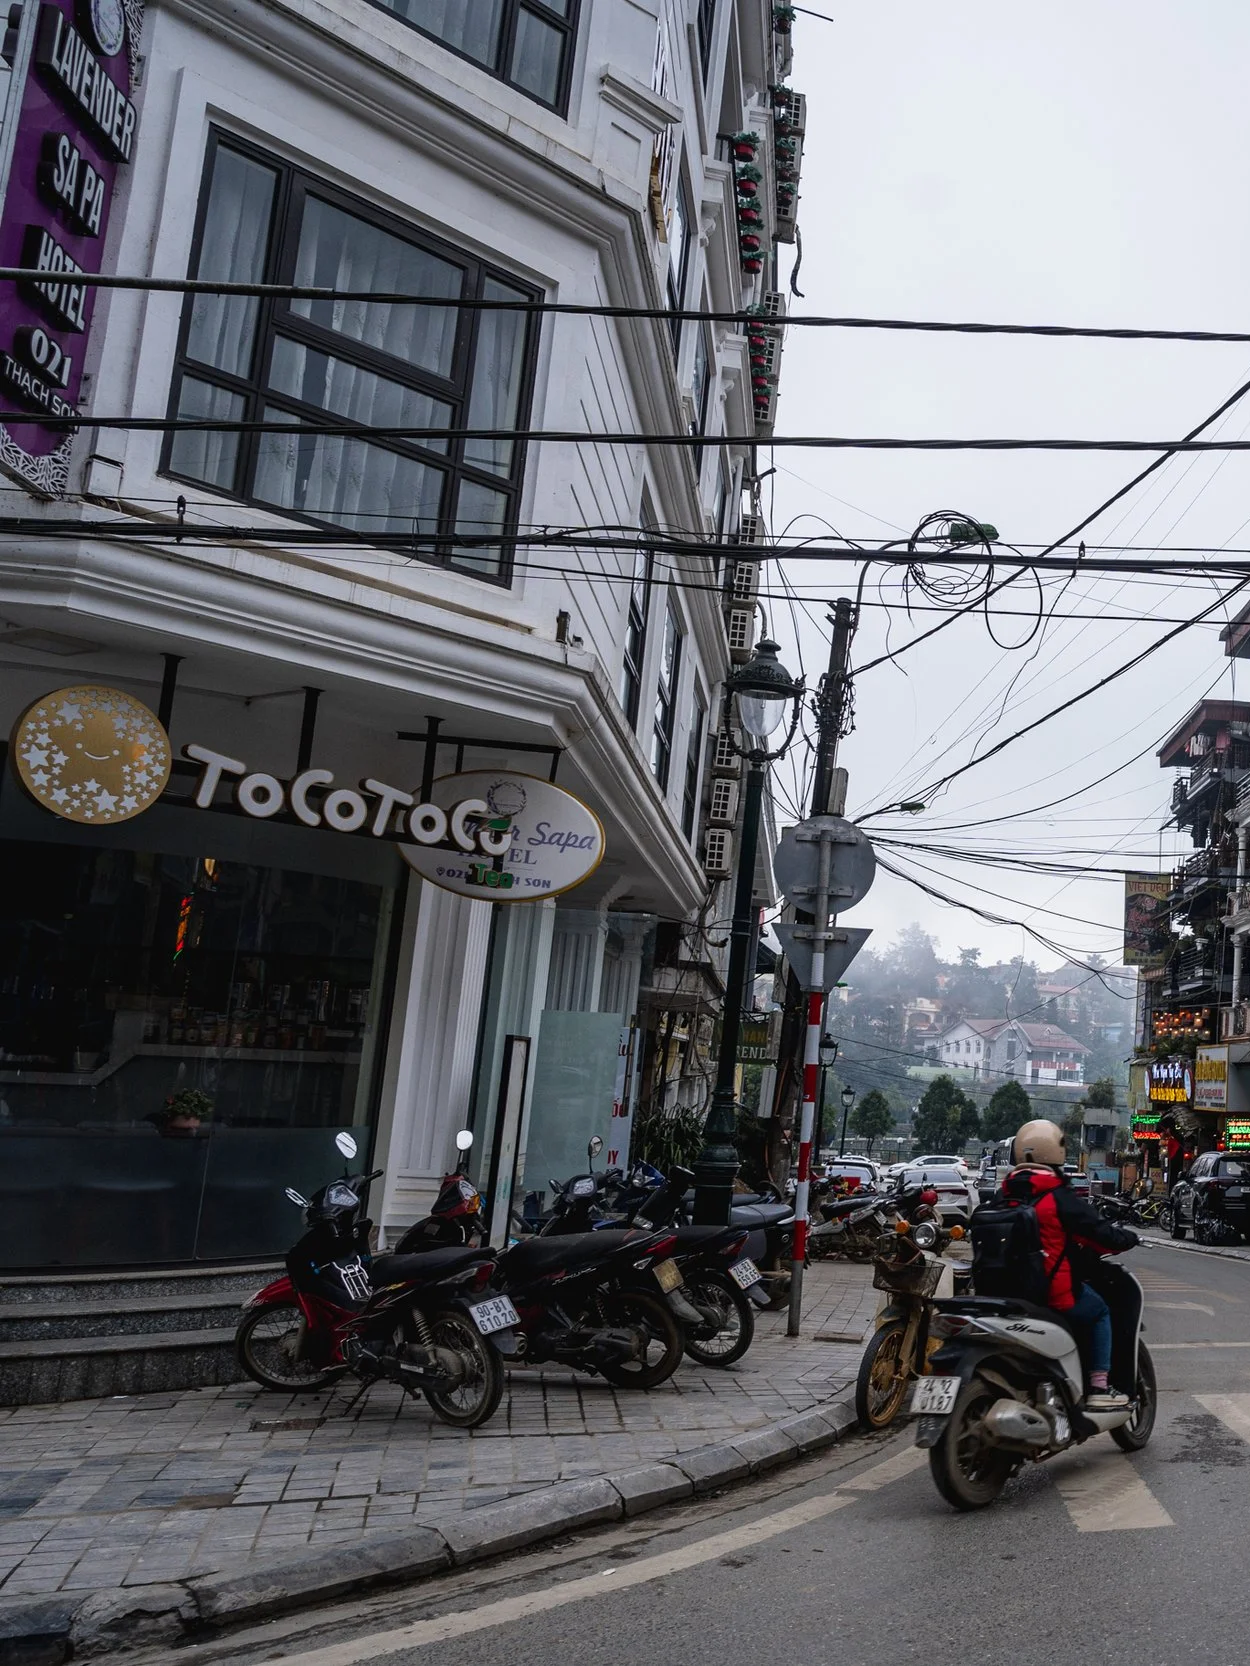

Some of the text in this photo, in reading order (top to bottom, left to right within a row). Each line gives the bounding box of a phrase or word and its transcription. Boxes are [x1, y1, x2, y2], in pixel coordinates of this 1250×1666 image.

[51, 11, 136, 159] LAVENDER
[54, 135, 105, 235] SA PA
[35, 232, 87, 331] HOTEL
[31, 329, 72, 386] 021
[5, 355, 50, 405] THẠCH
[528, 822, 595, 852] Sapa
[474, 863, 513, 888] Tea
[476, 1301, 507, 1319] 90-B1
[481, 1310, 517, 1332] 610.20
[1005, 1323, 1028, 1333] SH
